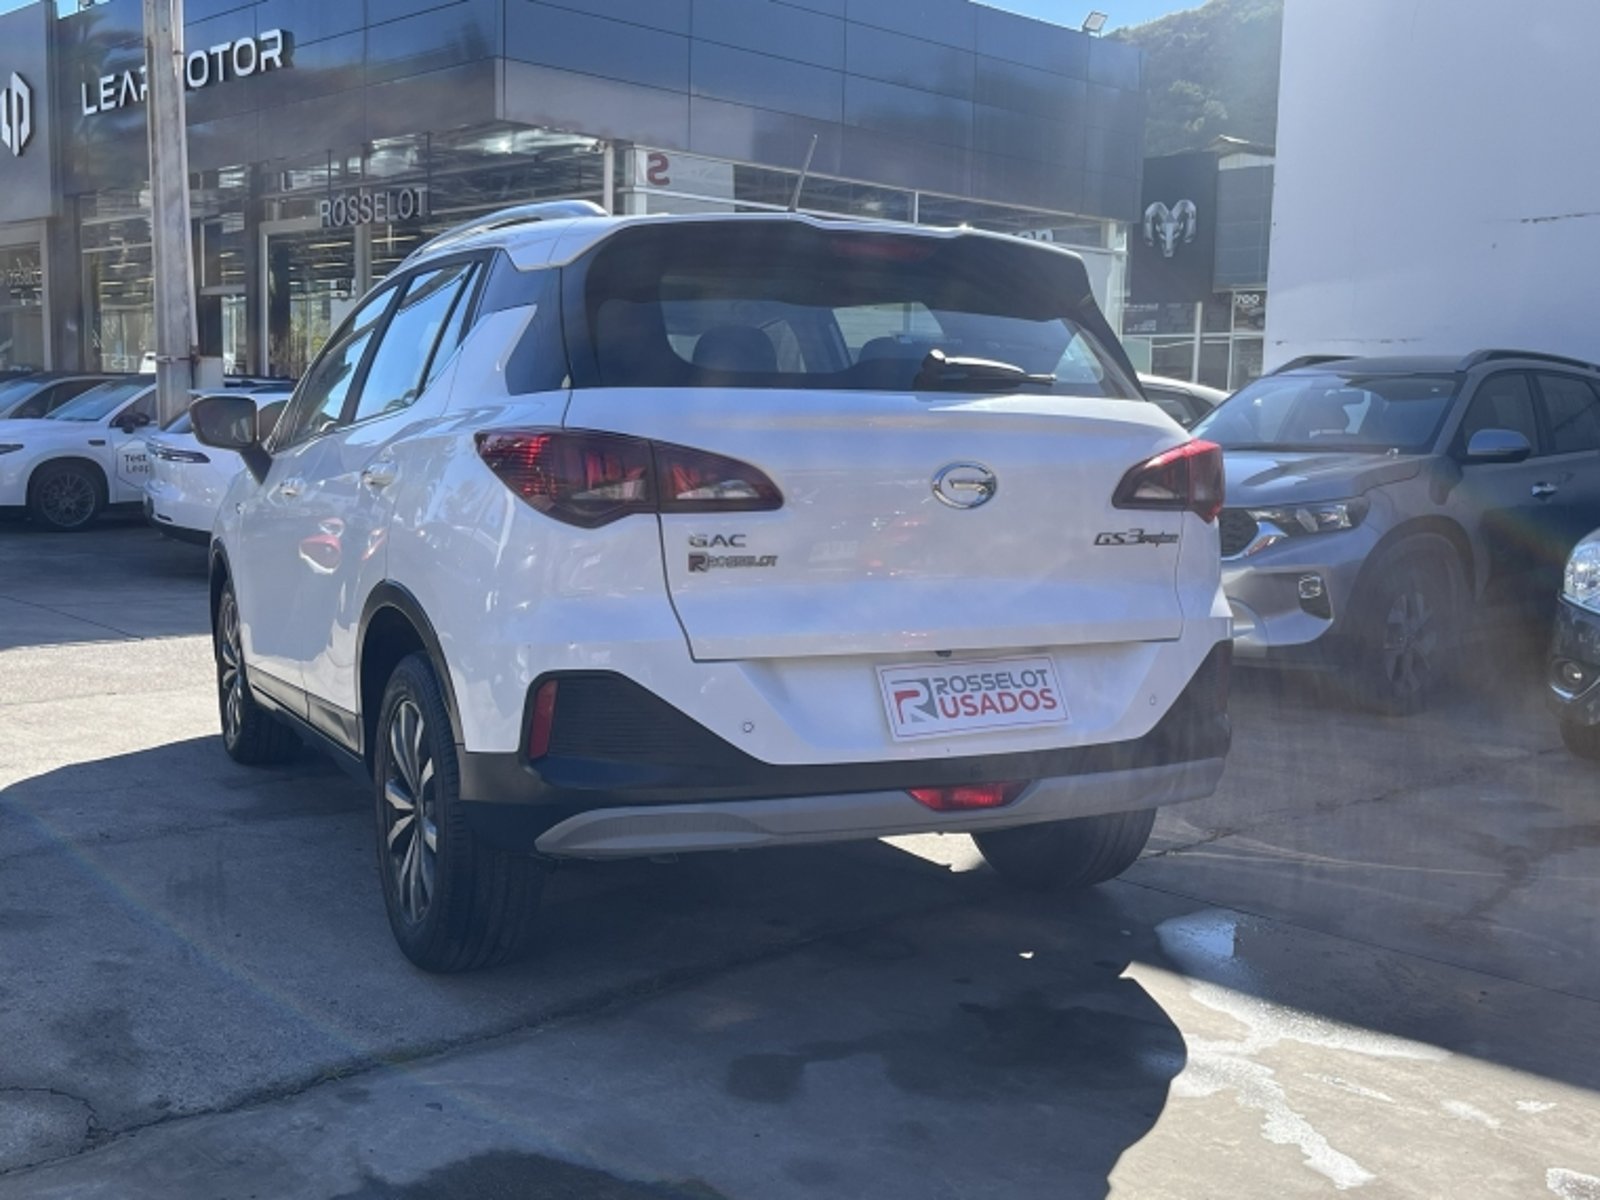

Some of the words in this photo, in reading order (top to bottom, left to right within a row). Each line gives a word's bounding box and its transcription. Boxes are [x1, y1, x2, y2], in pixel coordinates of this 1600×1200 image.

[81, 28, 283, 116] LEAOTOR
[320, 187, 428, 228] ROSSELOT
[688, 534, 747, 548] GAC
[932, 669, 1048, 696] ROSSELOT
[939, 688, 1058, 718] USADOS
